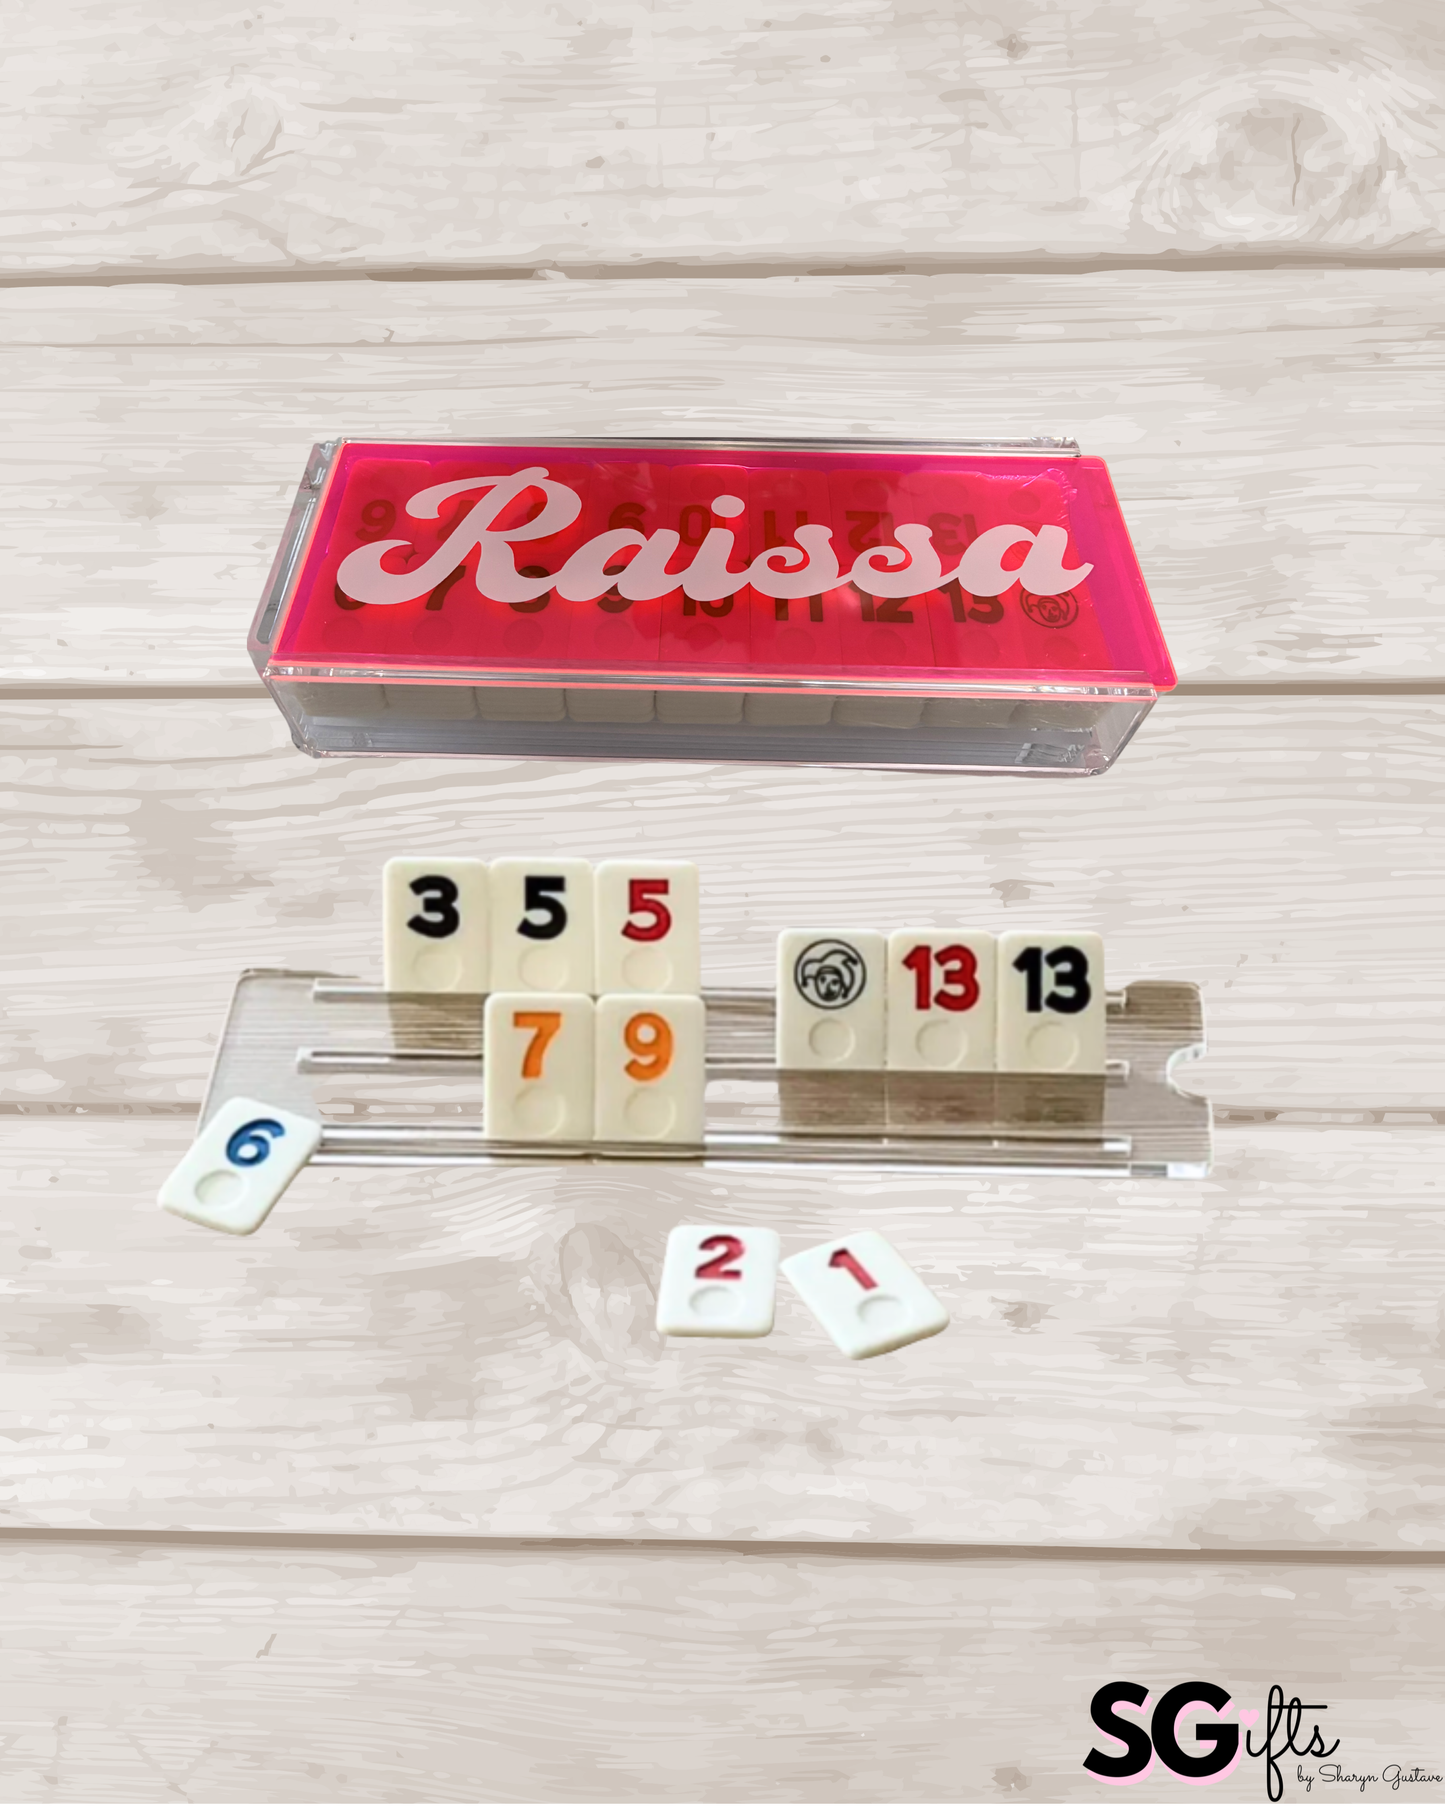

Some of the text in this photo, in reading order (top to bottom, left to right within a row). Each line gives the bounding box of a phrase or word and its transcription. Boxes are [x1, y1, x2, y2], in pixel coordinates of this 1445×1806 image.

[337, 467, 1094, 603] Raissa
[406, 875, 461, 938] 3
[516, 875, 568, 940] 5
[621, 879, 672, 942] 5
[902, 944, 980, 1011] 13
[1012, 945, 1091, 1014] 13
[512, 1012, 562, 1079] 7
[623, 1012, 674, 1081] 9
[225, 1118, 285, 1167] 6
[694, 1235, 745, 1280] 2
[828, 1247, 879, 1290] 1
